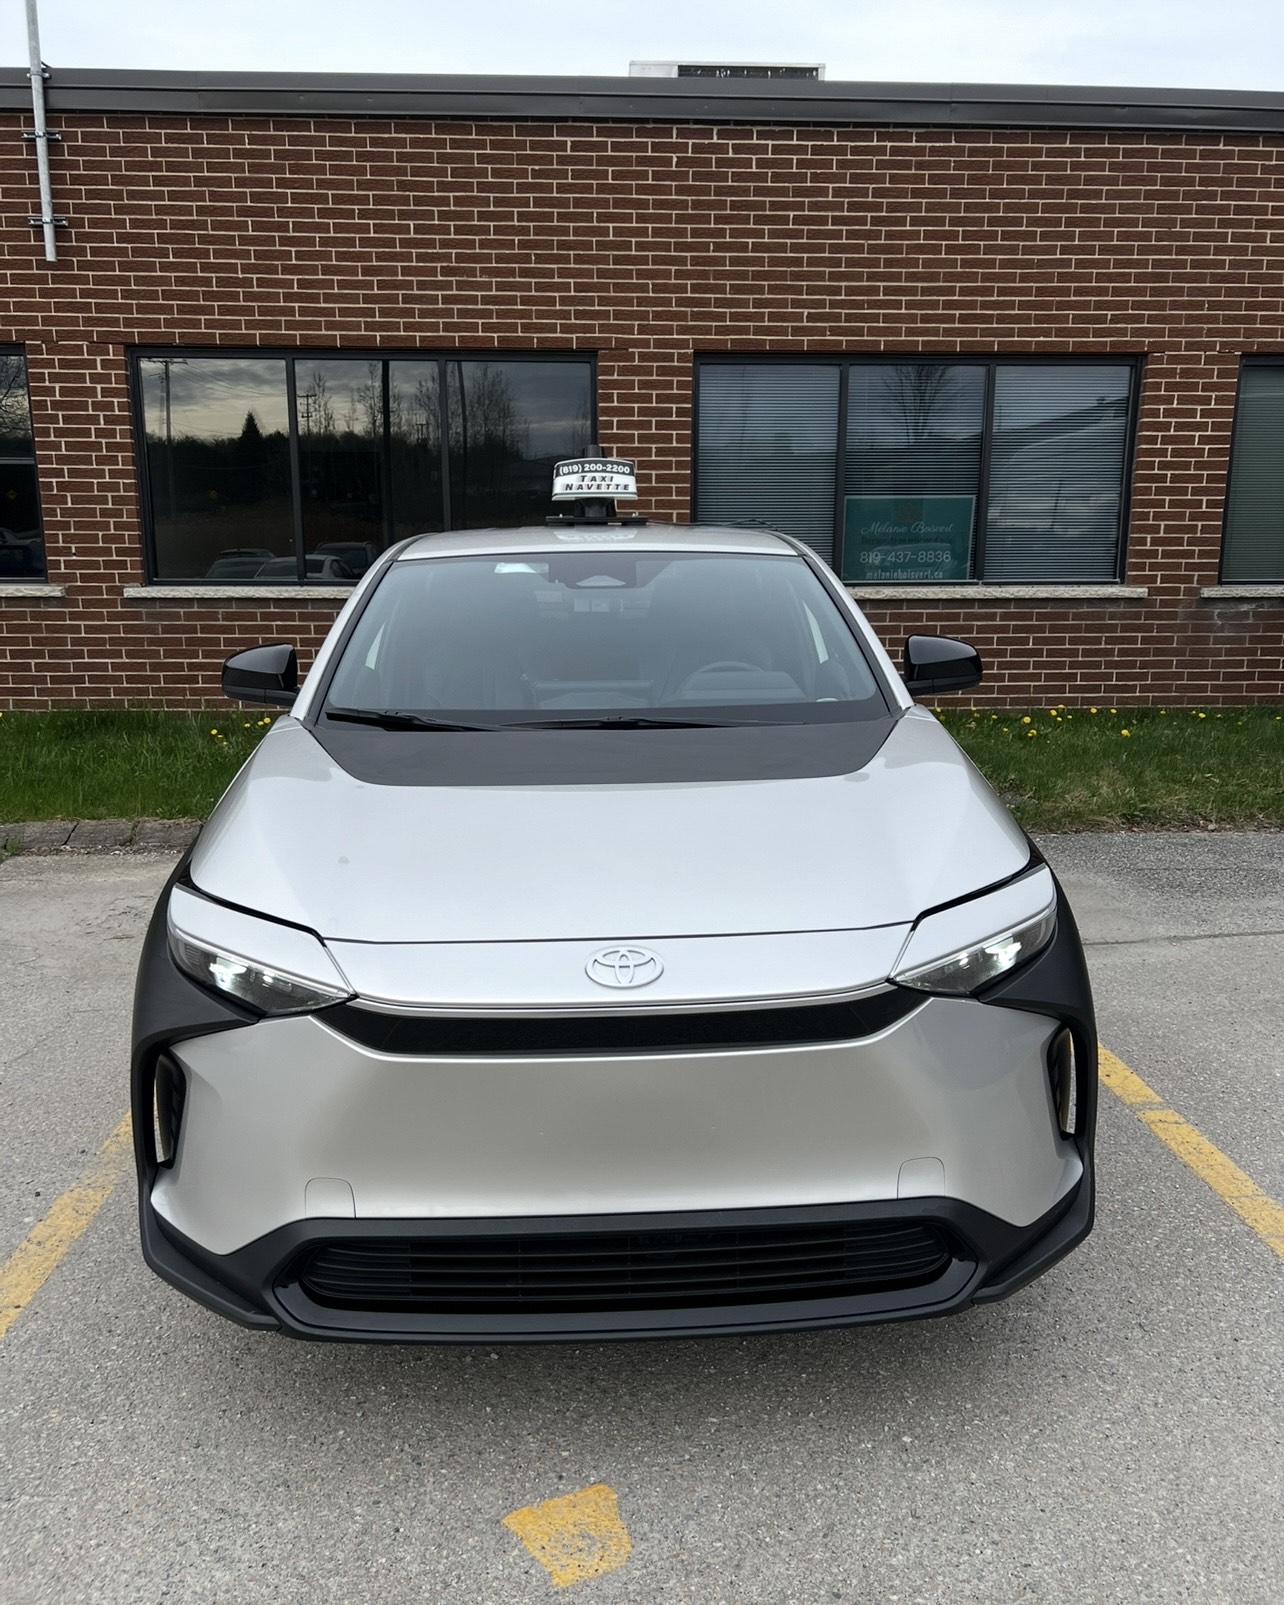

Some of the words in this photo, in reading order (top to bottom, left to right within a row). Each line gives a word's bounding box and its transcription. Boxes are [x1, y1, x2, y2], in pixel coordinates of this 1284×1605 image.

[559, 464, 582, 475] (819)
[584, 464, 630, 473] 200-2200
[860, 551, 951, 563] 819-437-8836
